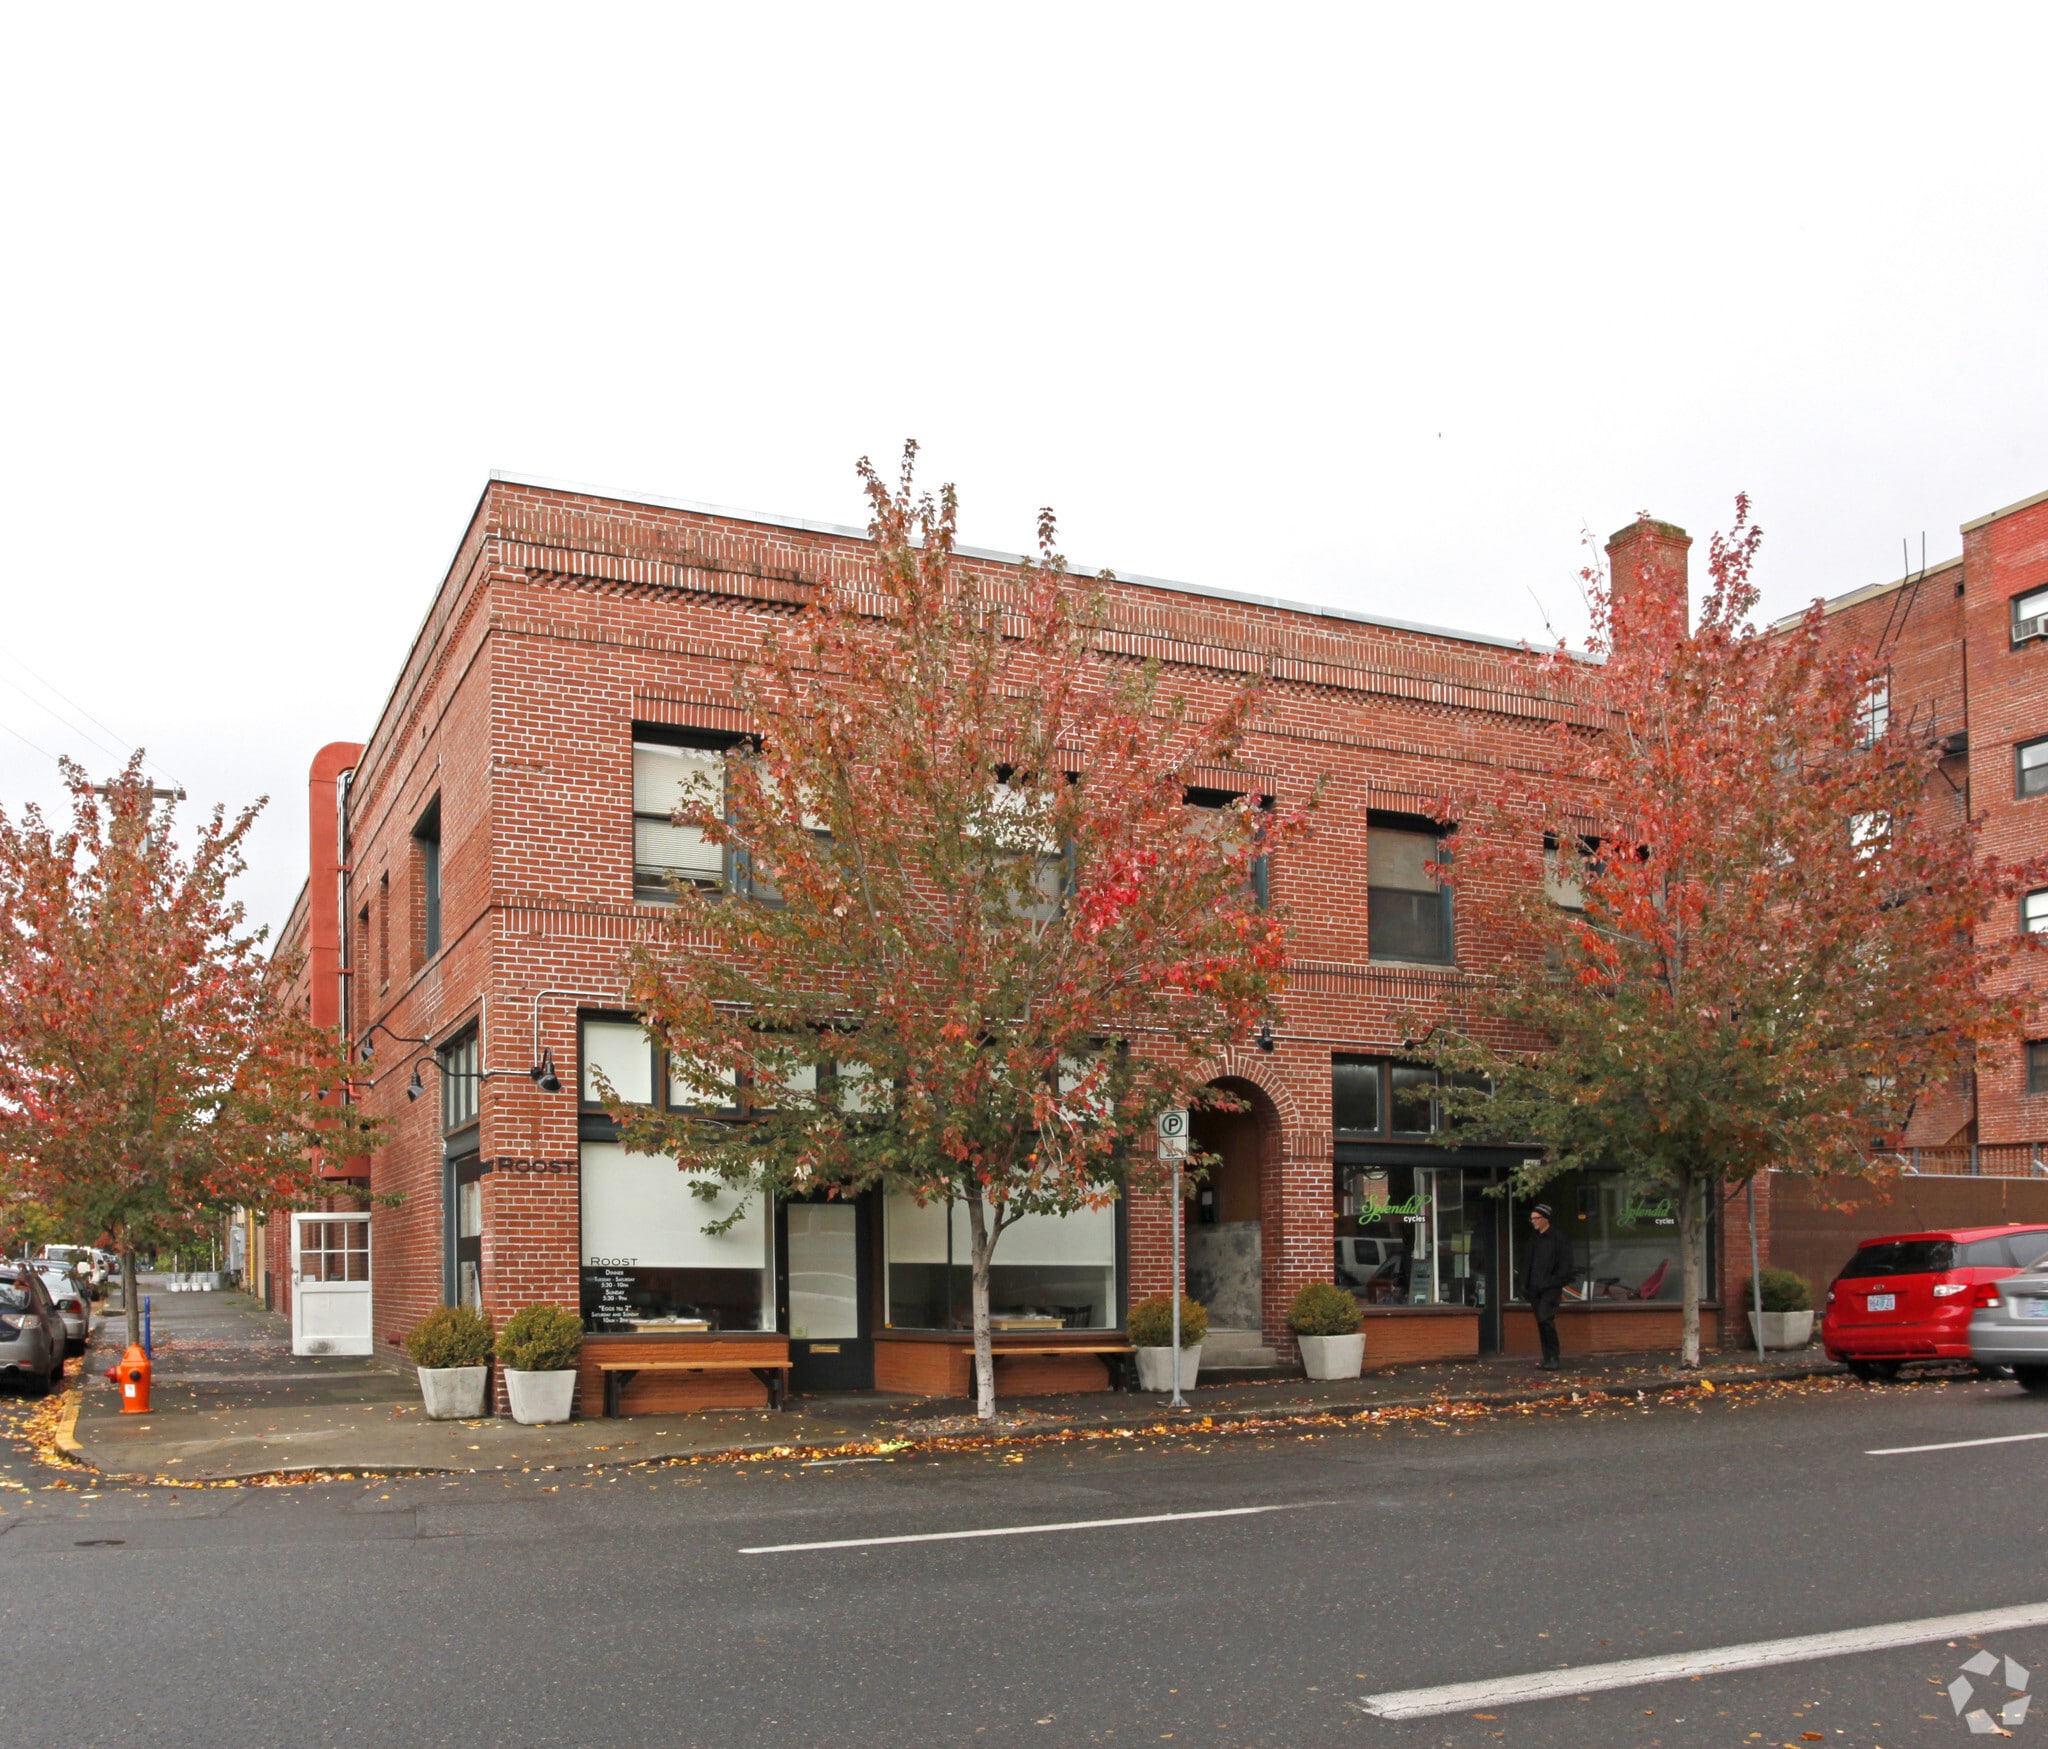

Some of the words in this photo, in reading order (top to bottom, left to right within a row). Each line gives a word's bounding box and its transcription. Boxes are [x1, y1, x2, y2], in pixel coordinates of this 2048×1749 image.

[1168, 1118, 1179, 1132] P
[498, 1156, 576, 1174] ROOST
[1358, 1193, 1432, 1225] Splendid
[1617, 1199, 1679, 1227] Splendid
[1403, 1215, 1426, 1224] cycles
[1655, 1217, 1675, 1225] cycles
[590, 1256, 638, 1266] ROOST
